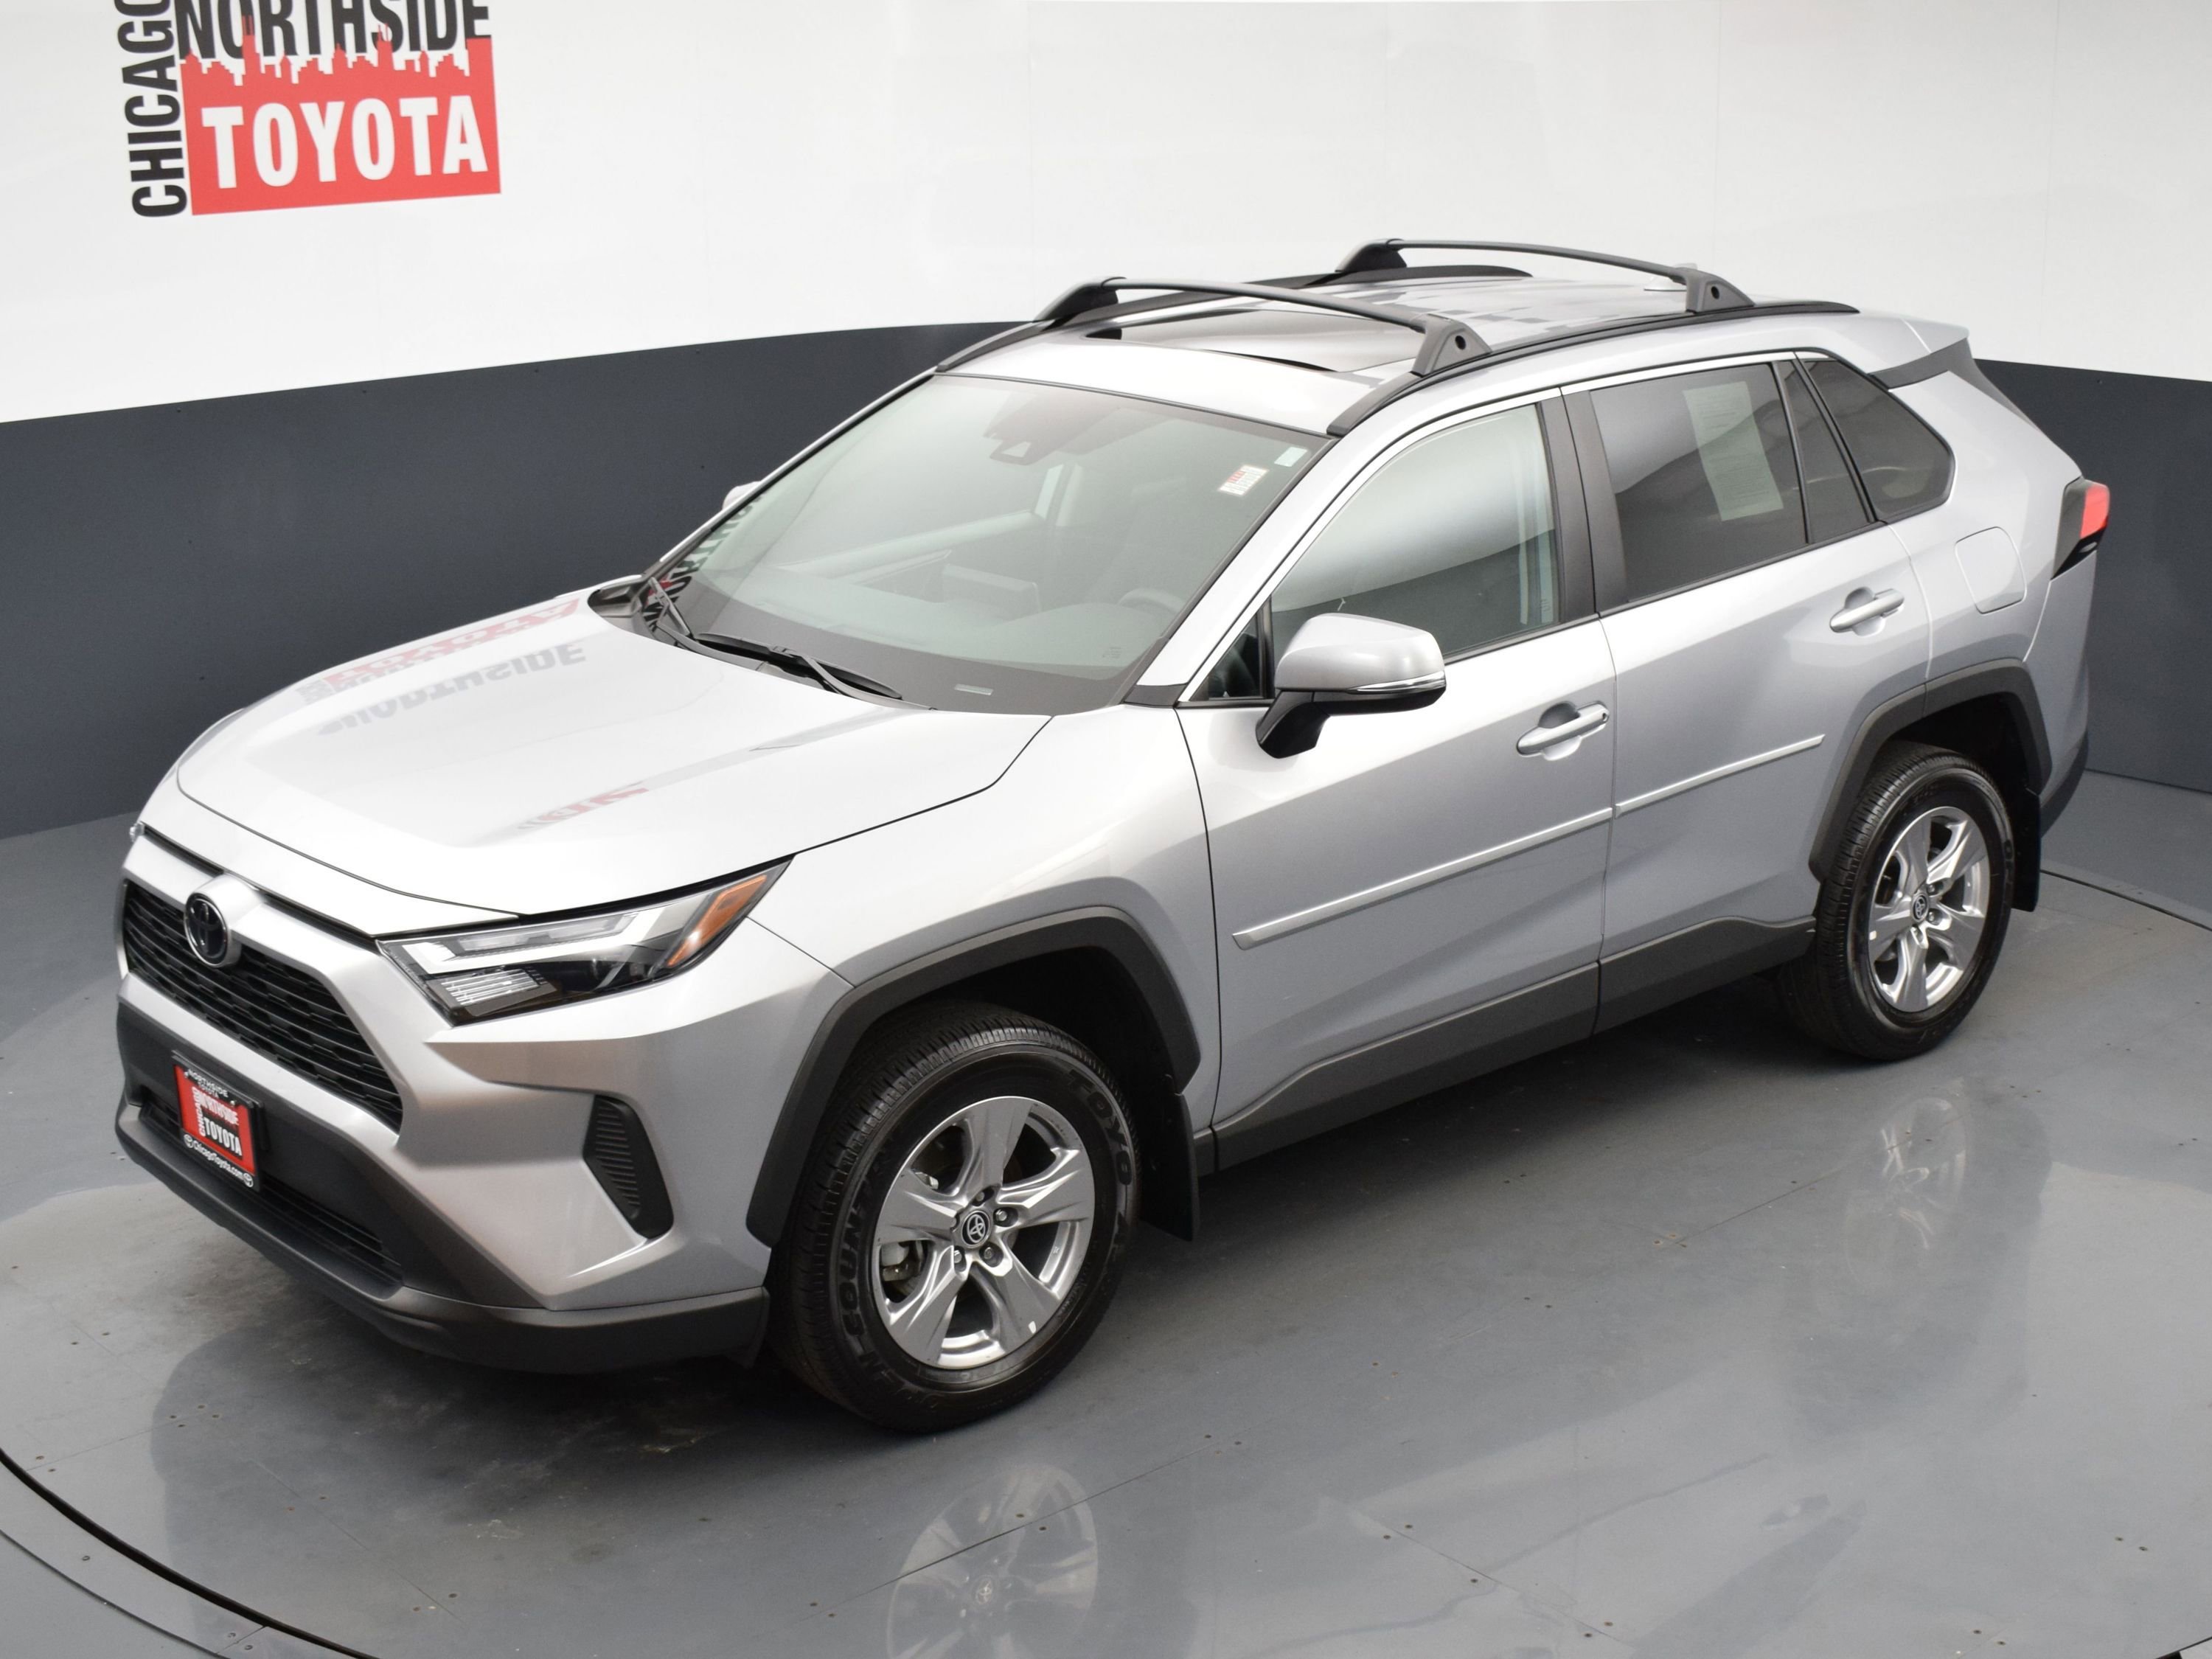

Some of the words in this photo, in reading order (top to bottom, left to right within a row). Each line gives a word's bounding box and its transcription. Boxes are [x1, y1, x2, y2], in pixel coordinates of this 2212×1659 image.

[174, 0, 491, 60] NORTHSIDE
[201, 95, 488, 189] TOYOTA
[204, 1117, 243, 1156] TOYOTA
